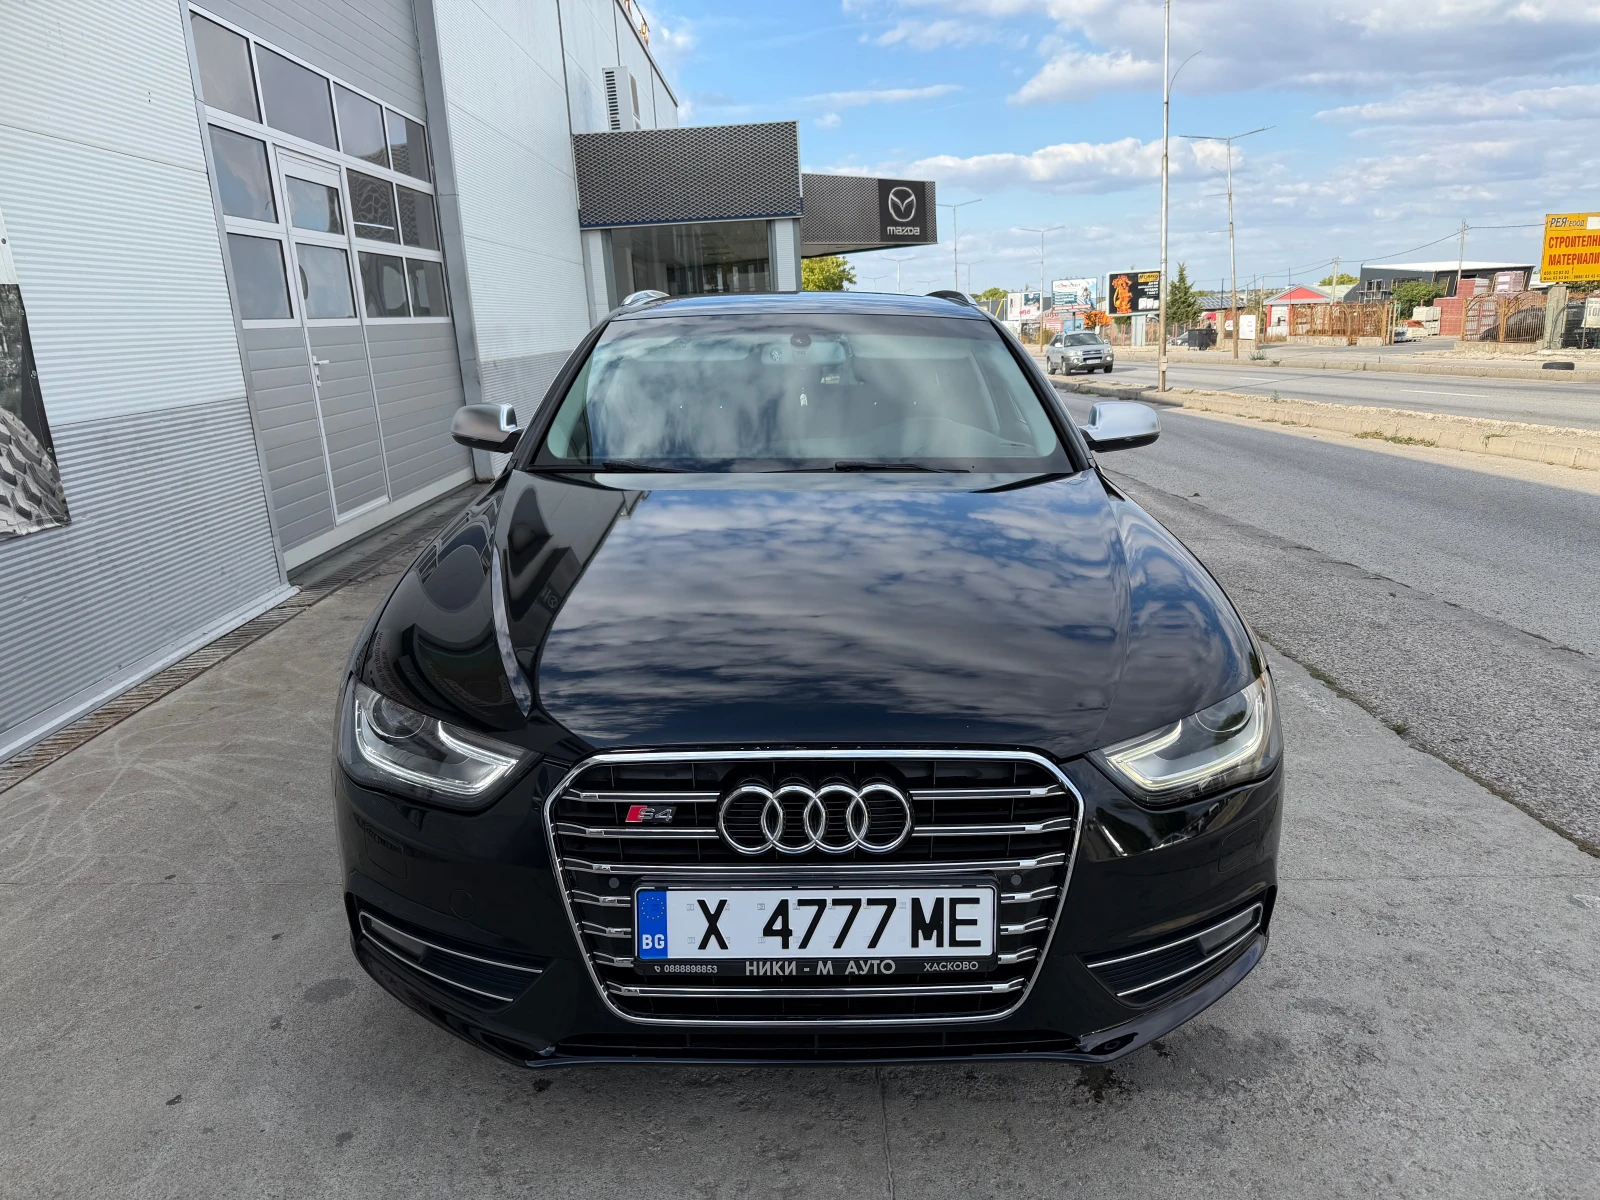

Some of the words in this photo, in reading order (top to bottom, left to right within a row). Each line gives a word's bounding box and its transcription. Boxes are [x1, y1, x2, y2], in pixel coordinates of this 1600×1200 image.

[887, 226, 920, 235] mazda
[637, 807, 673, 822] S4
[696, 899, 729, 950] X
[763, 898, 897, 950] 4777
[910, 897, 982, 948] ME
[642, 934, 665, 949] BG
[664, 964, 718, 974] 0888898853
[745, 961, 797, 976] НИКИ
[816, 960, 834, 975] М
[845, 960, 896, 975] АУТО
[923, 961, 979, 972] ХАСКОВО
